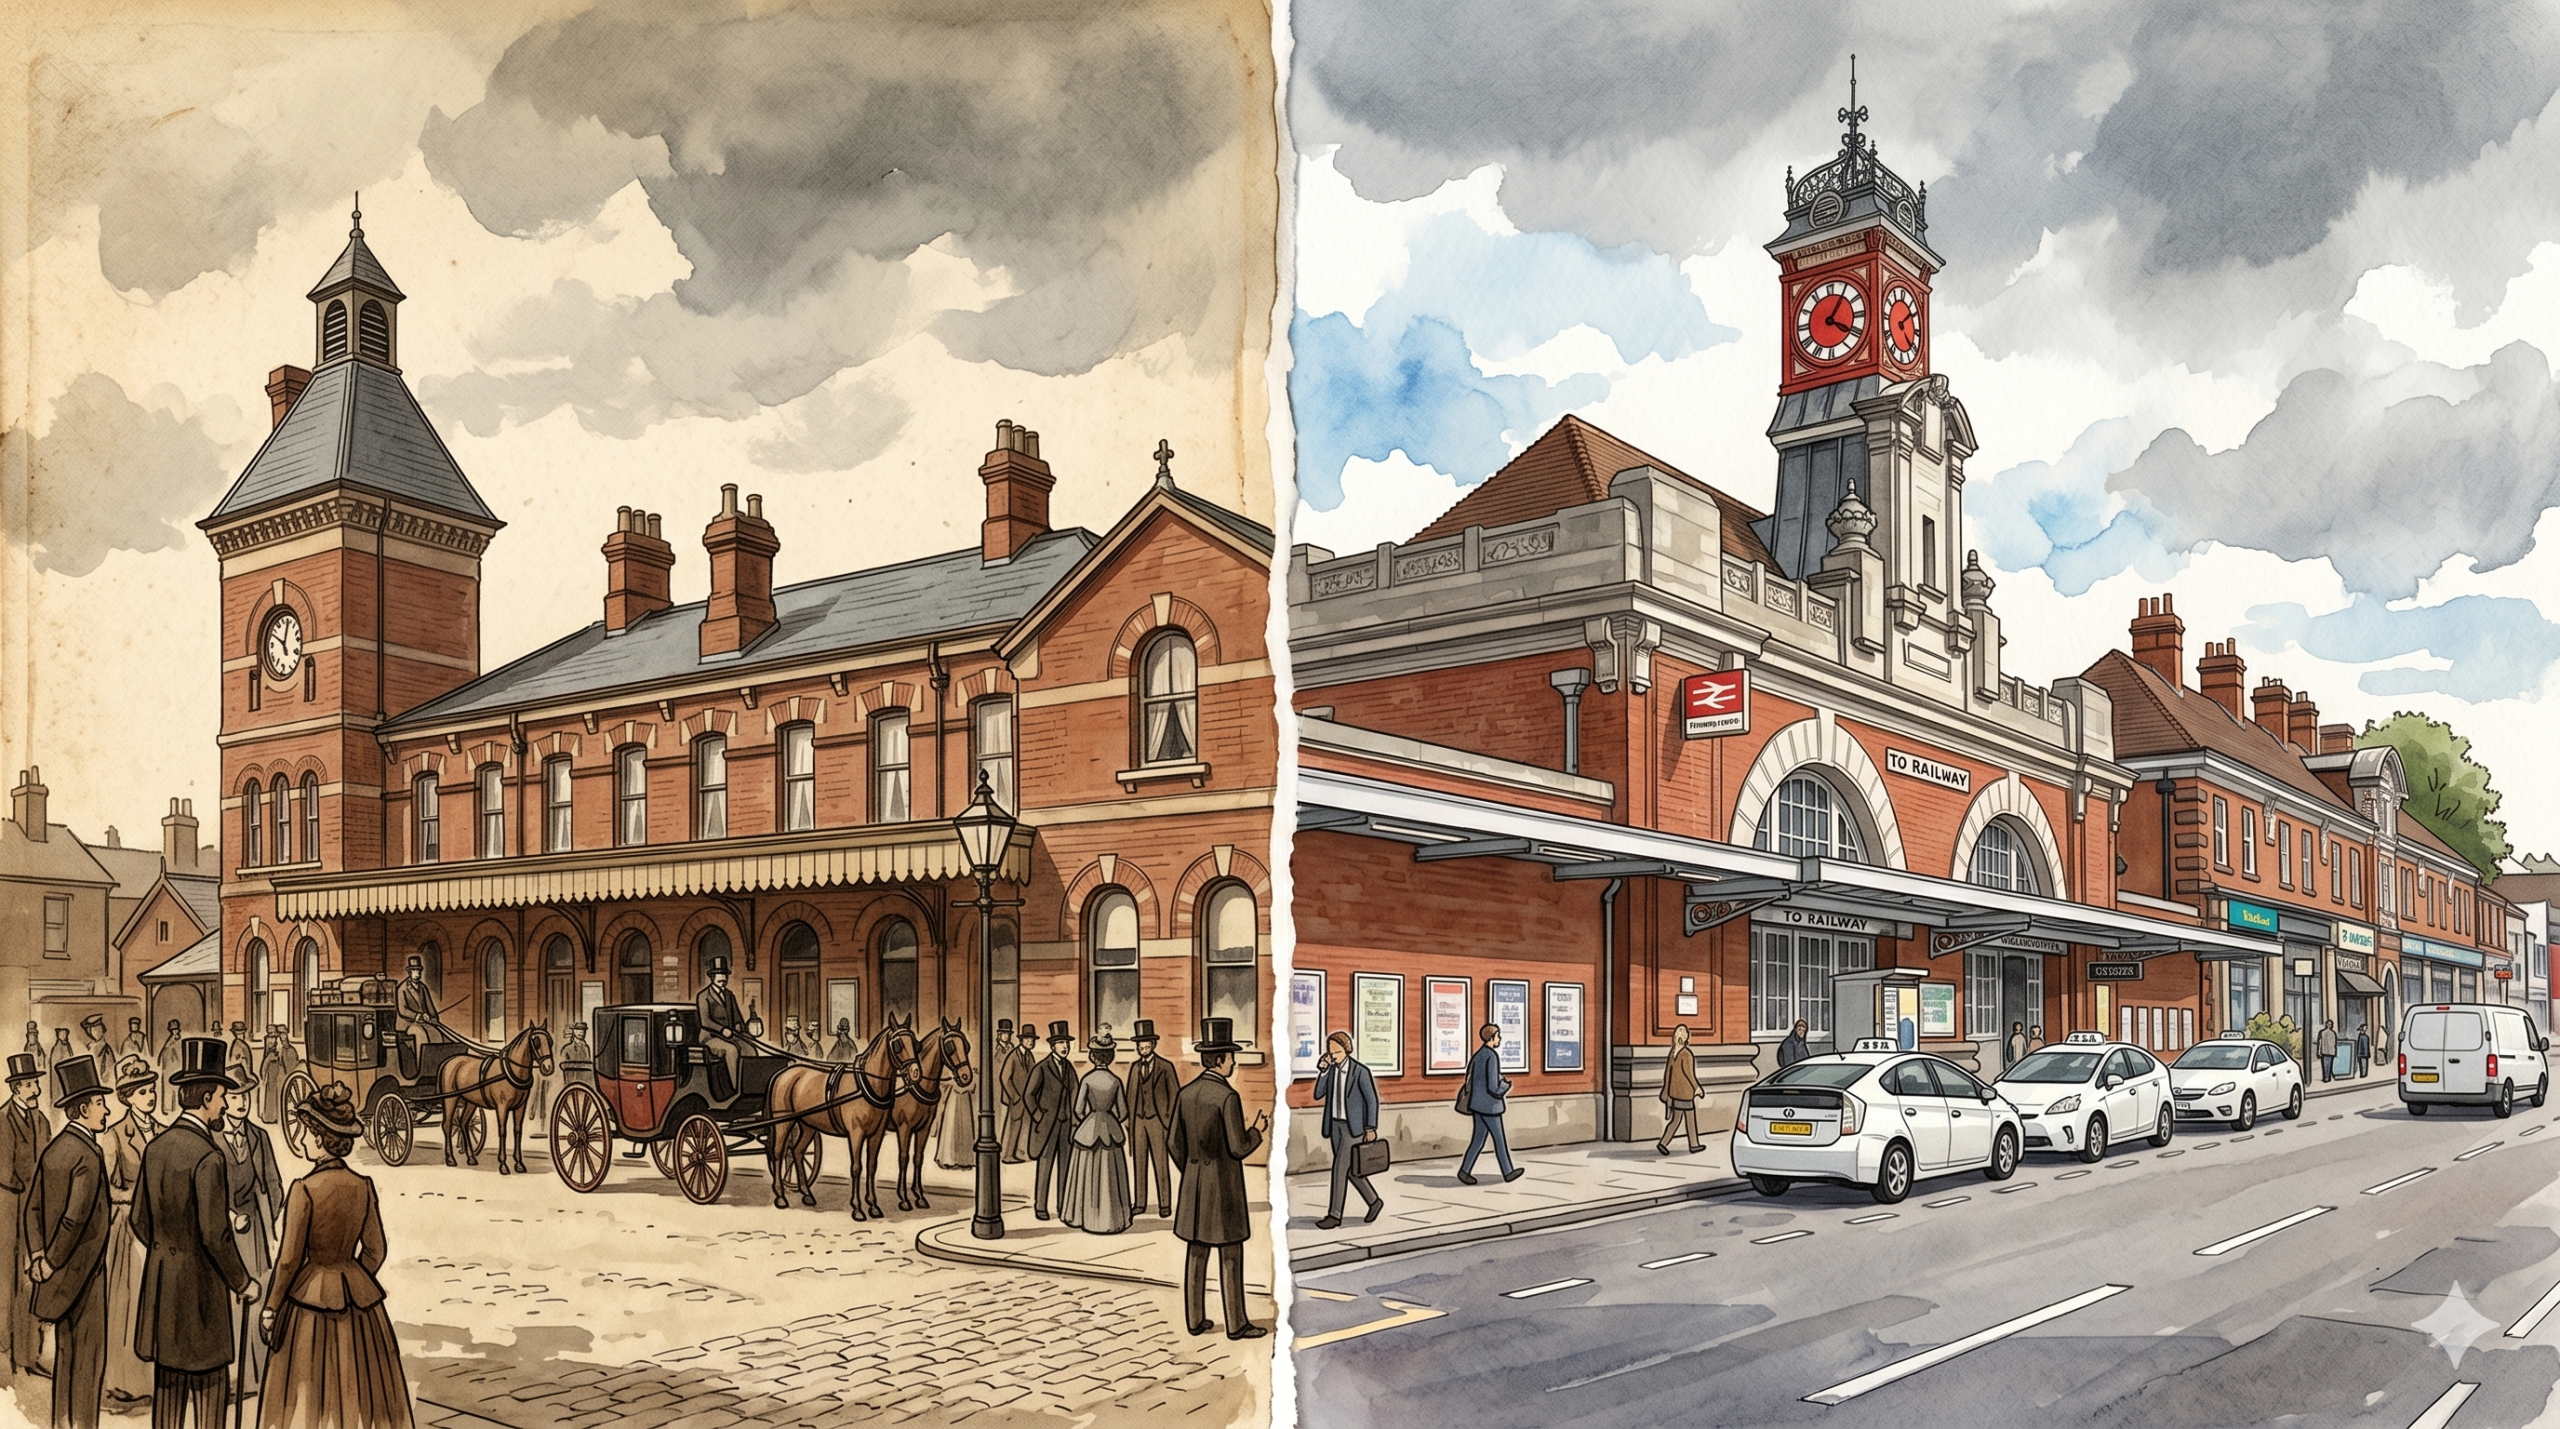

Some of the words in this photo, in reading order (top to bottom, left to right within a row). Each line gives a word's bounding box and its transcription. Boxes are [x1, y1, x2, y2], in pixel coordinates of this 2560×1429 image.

[1889, 753, 1907, 769] TO
[1912, 759, 1967, 786] RAILWAY
[1783, 911, 1802, 922] TO
[1807, 913, 1868, 930] RAILWAY
